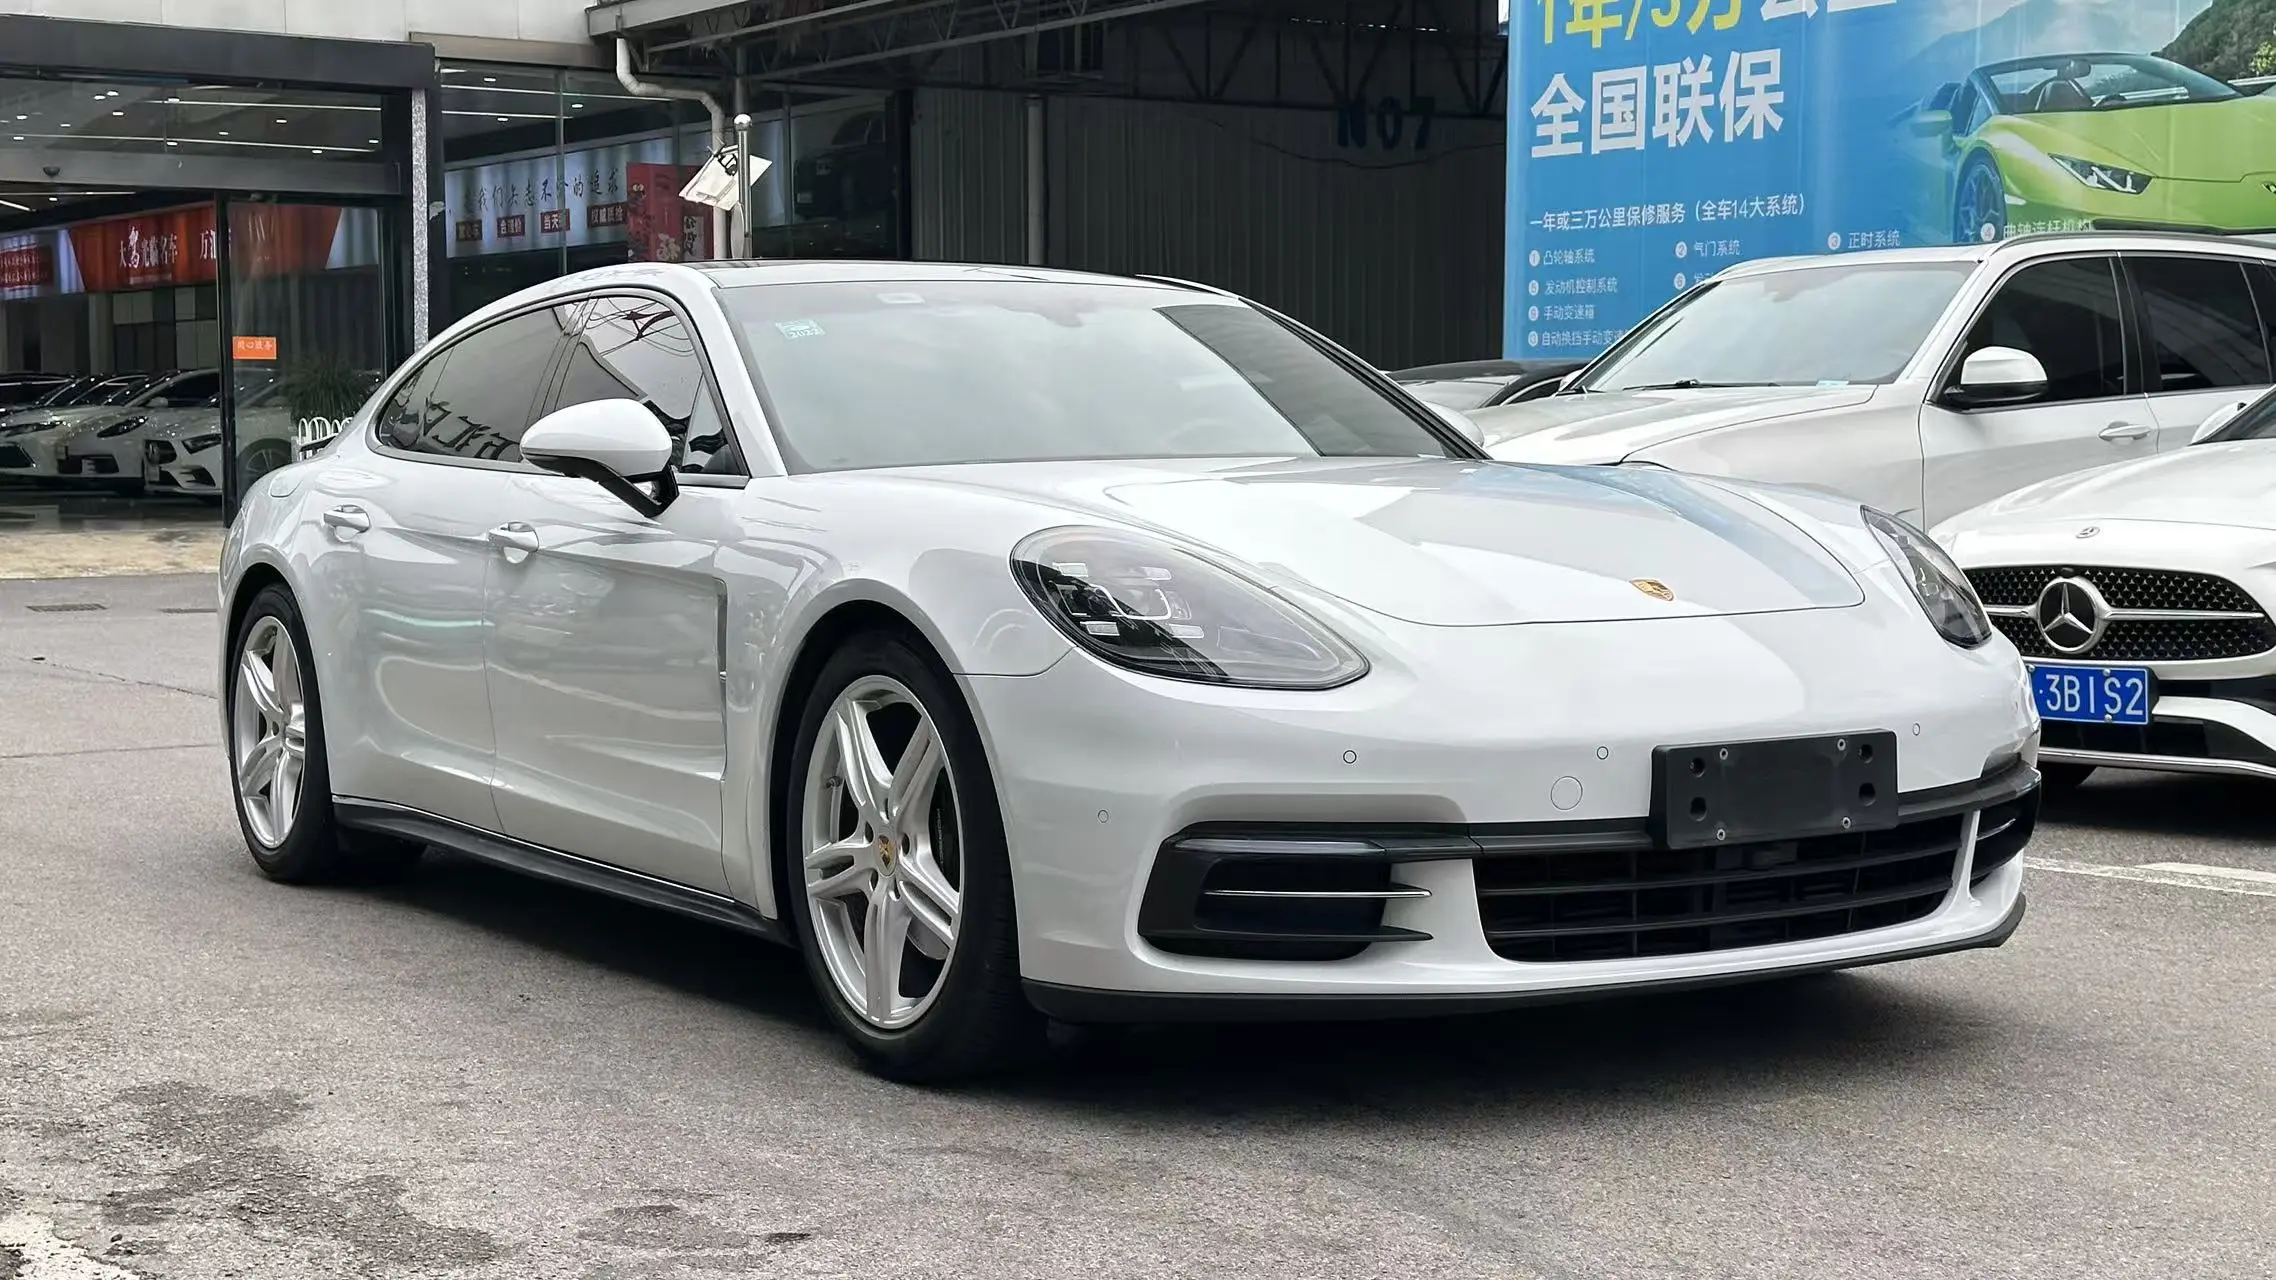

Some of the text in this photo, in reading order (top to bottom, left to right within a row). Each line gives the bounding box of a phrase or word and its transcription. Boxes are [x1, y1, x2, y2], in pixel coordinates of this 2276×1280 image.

[1530, 48, 1785, 158] 全国联保
[1694, 239, 1741, 257] 气门系统
[1848, 229, 1900, 249] 正时系统
[1543, 248, 1596, 265] 凸轮轴系统
[1544, 277, 1617, 296] 发动机控制系统
[1543, 303, 1595, 321] 手动变速箱
